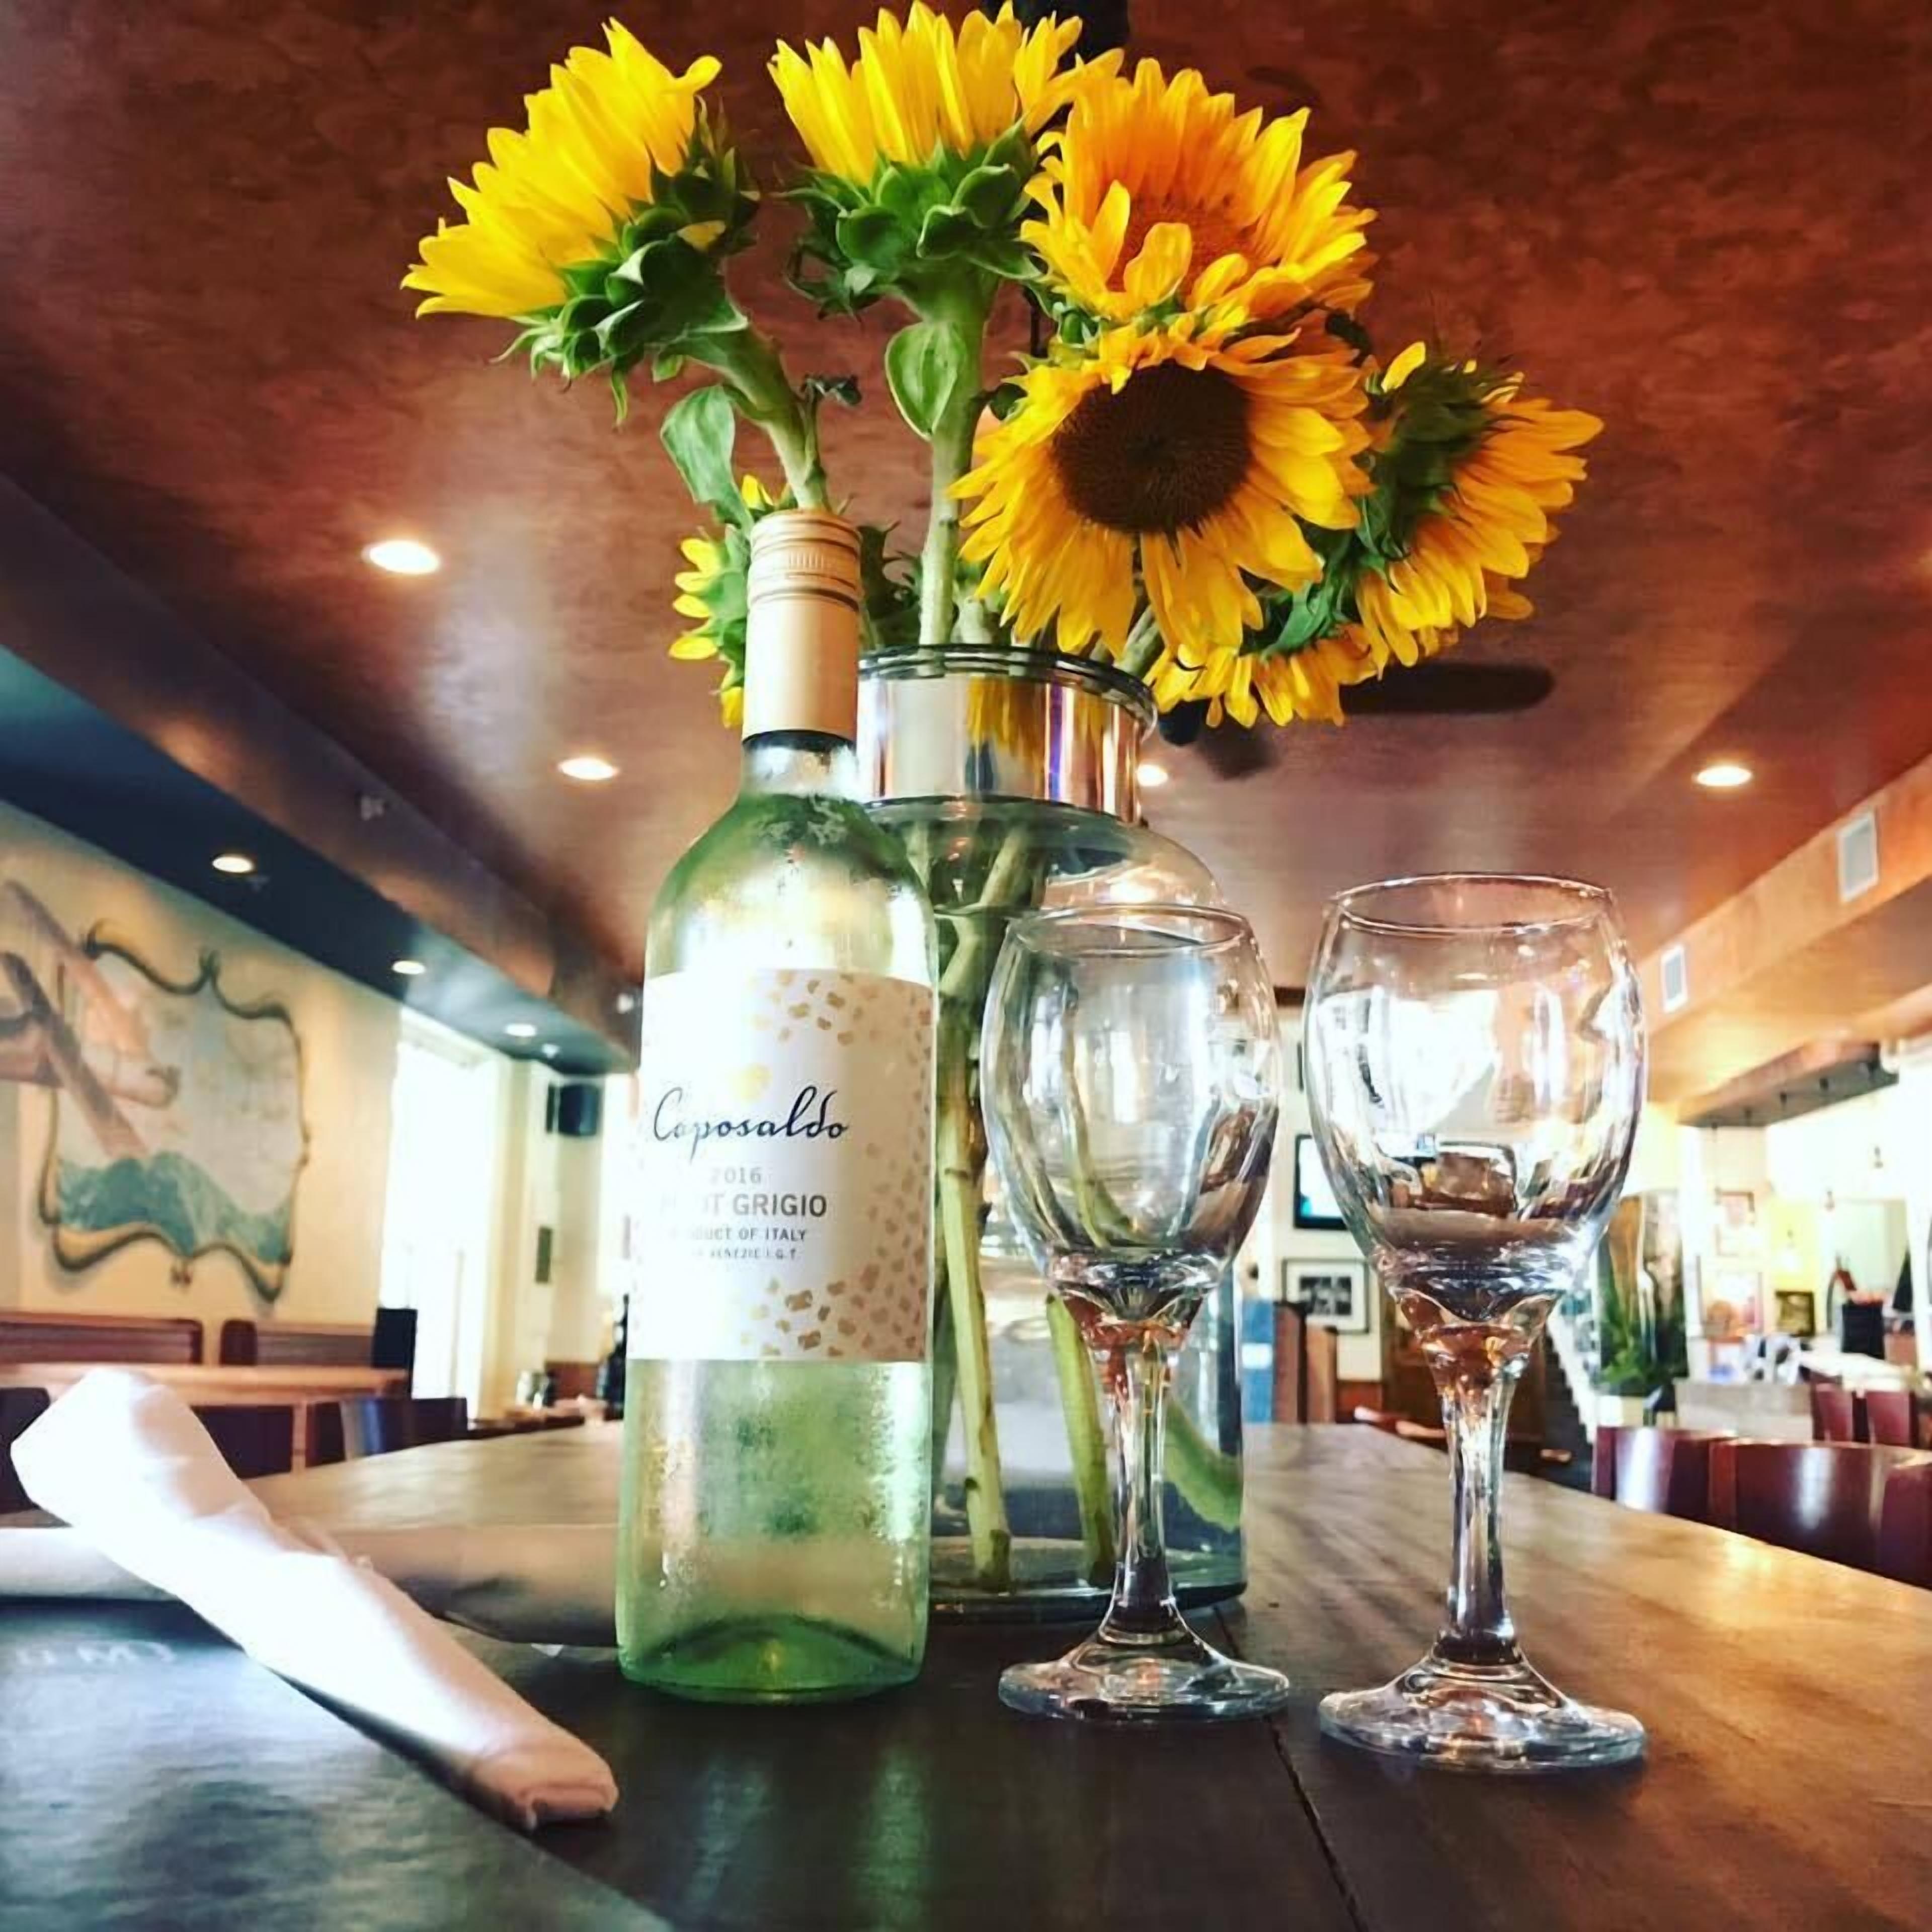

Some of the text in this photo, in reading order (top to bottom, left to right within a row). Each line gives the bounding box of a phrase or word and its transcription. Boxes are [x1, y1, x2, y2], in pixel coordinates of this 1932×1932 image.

[710, 1166, 761, 1184] 2016
[733, 1193, 827, 1218] GRIGIO
[738, 1228, 758, 1240] OF
[766, 1227, 807, 1242] ITALY
